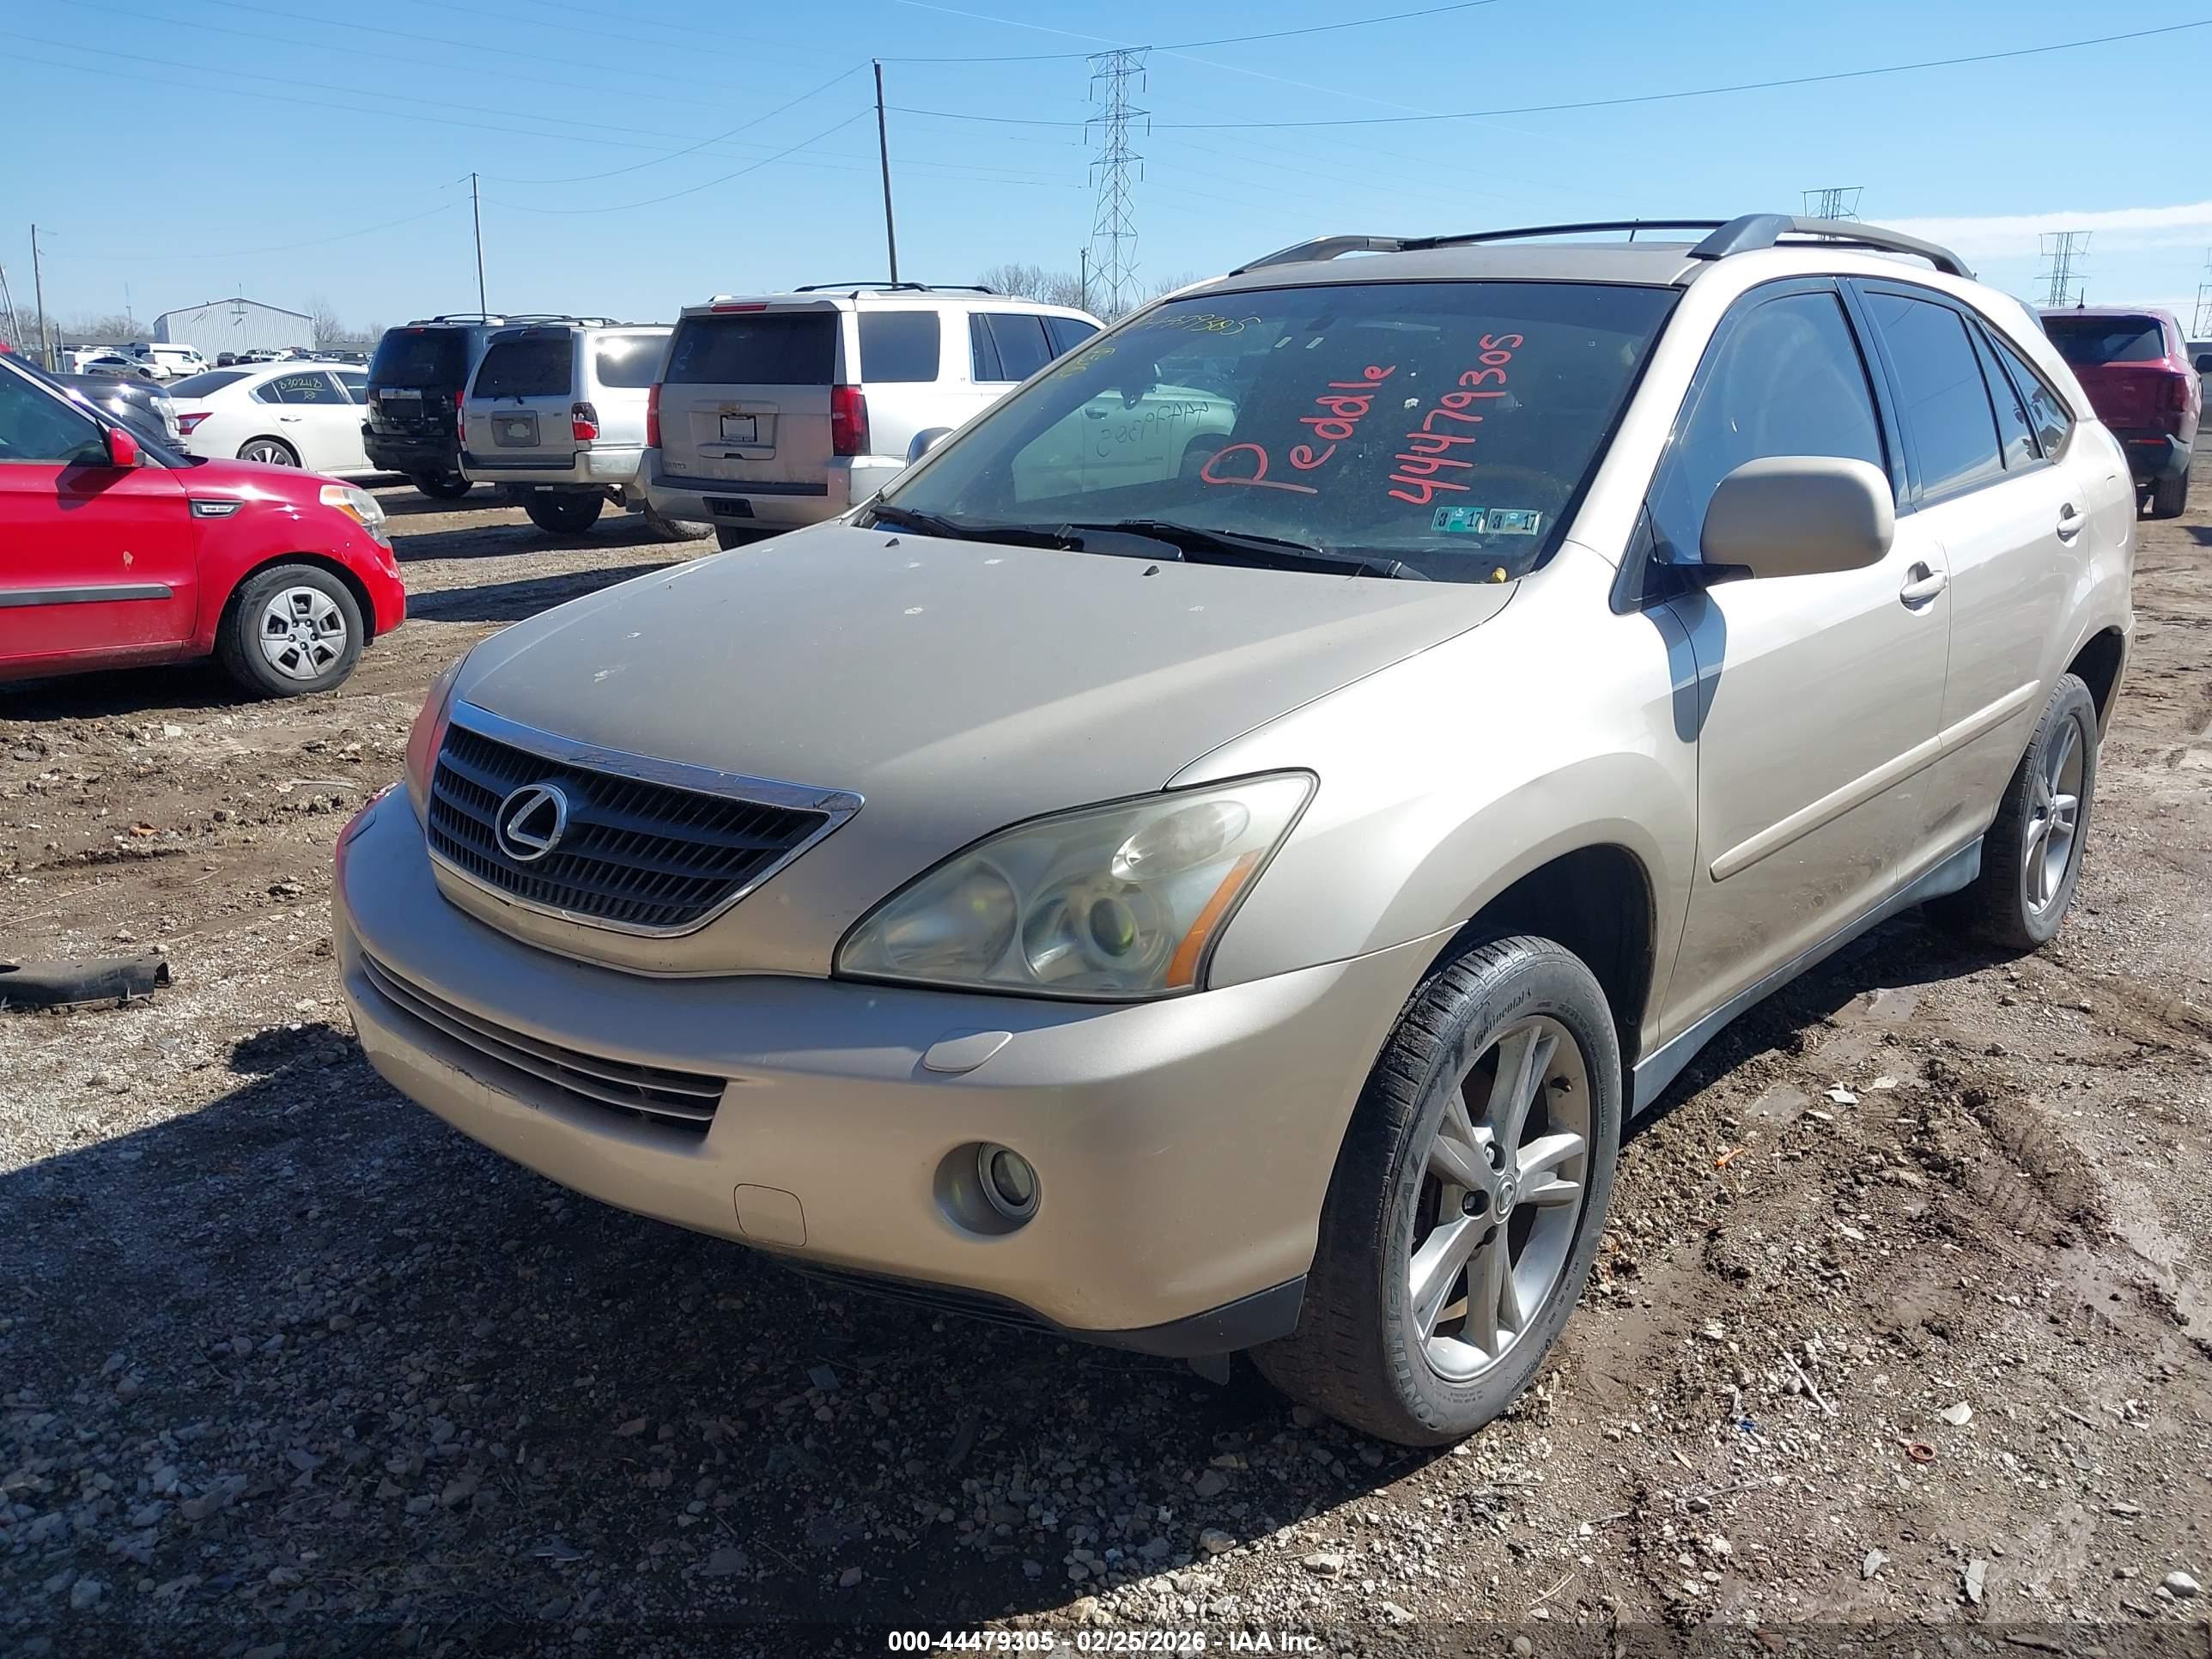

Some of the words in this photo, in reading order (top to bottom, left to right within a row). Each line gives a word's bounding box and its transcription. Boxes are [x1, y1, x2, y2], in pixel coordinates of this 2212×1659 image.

[1201, 364, 1396, 495] Peddle
[1388, 333, 1523, 505] 44479305
[1437, 512, 1449, 527] 3
[1467, 511, 1483, 528] 17
[1492, 514, 1503, 529] 3
